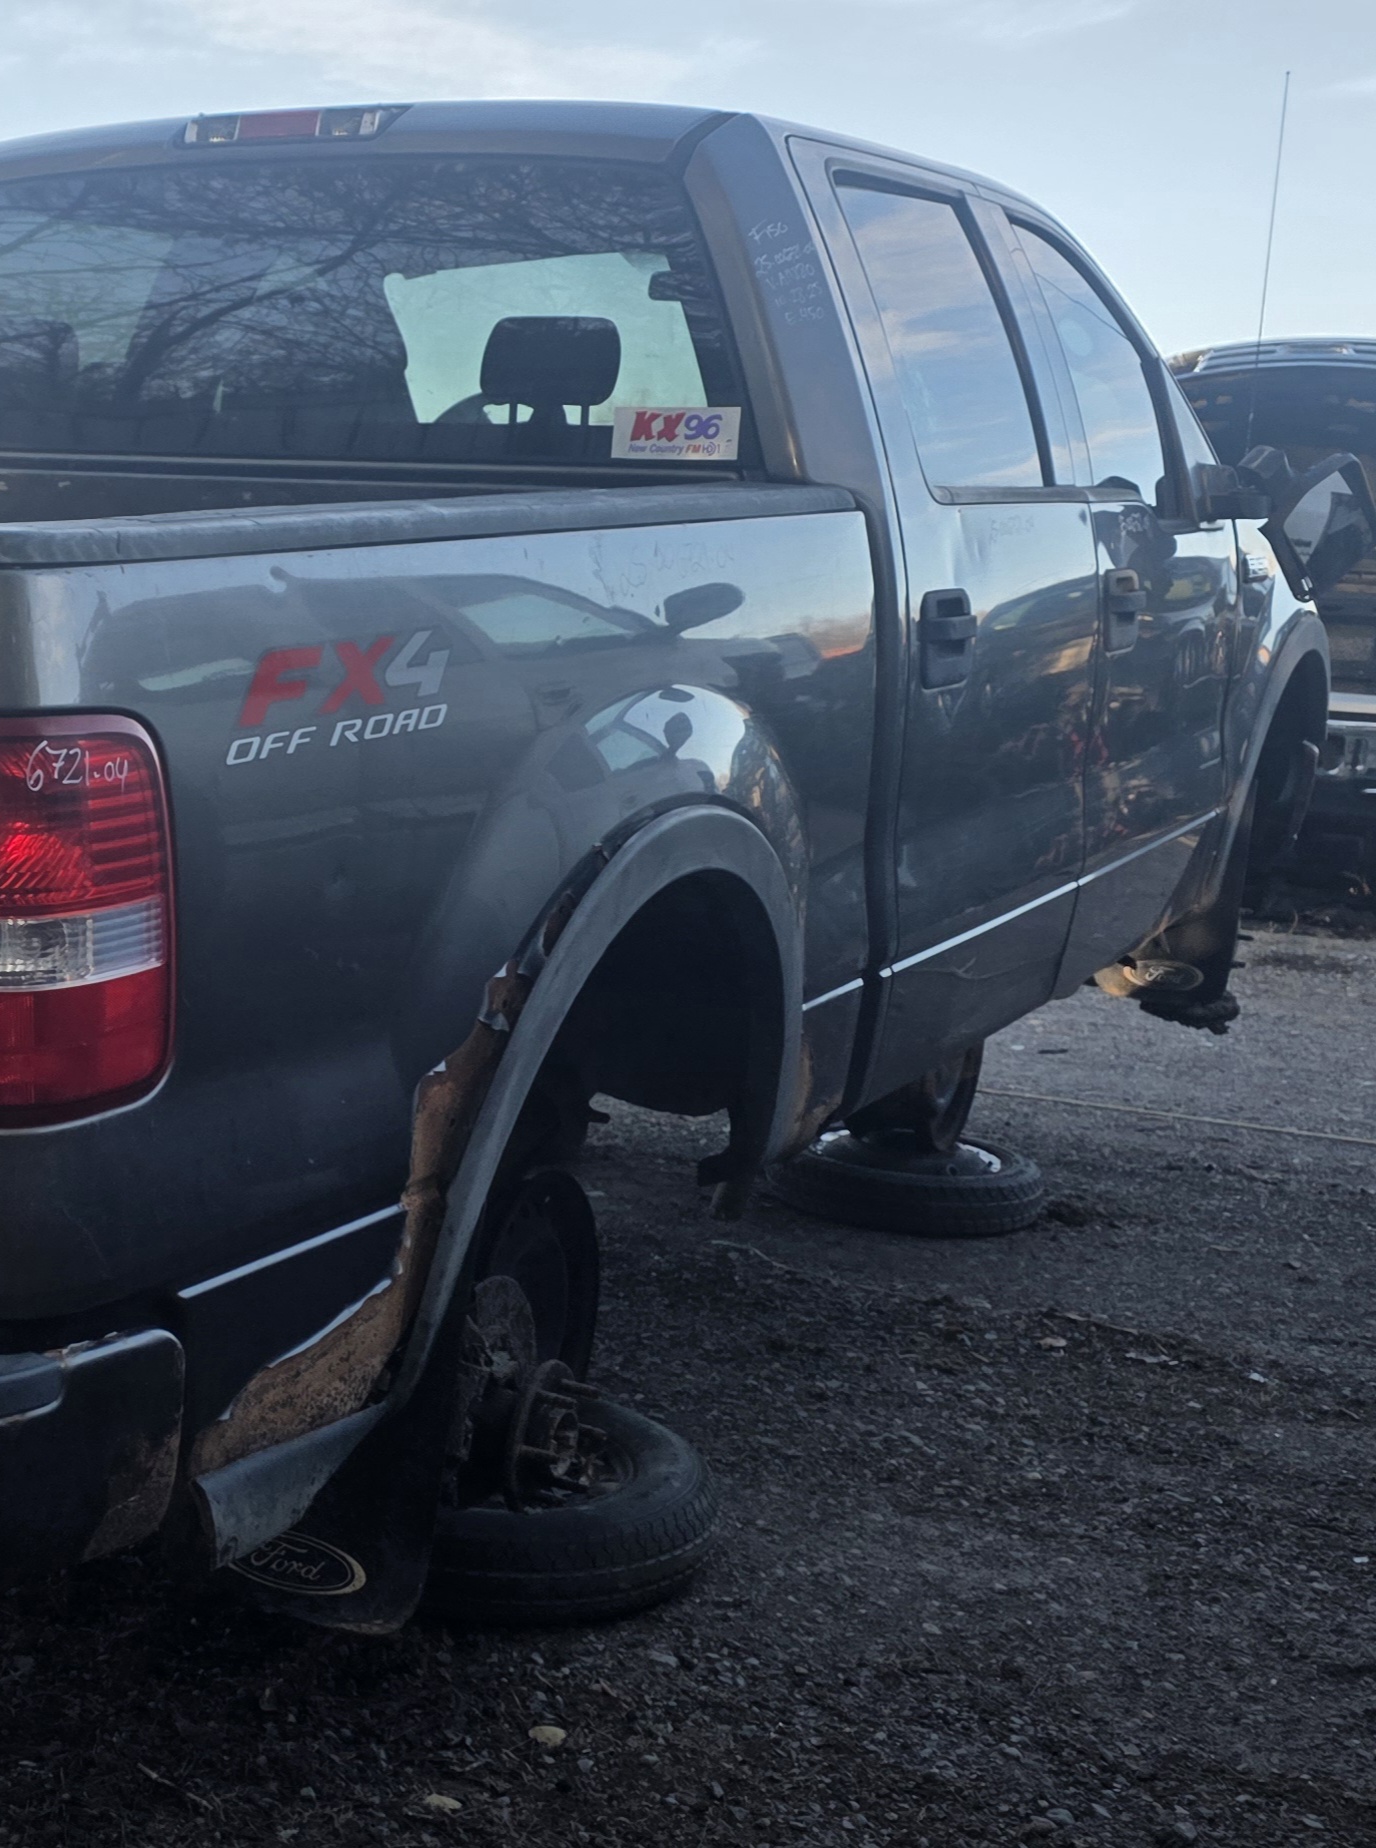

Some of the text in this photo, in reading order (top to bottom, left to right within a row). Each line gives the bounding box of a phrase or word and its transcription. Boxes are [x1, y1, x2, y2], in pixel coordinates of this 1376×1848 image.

[649, 443, 684, 455] Country
[685, 444, 701, 454] FM
[238, 629, 451, 728] FX4
[226, 703, 448, 766] OFF ROAD
[250, 1538, 326, 1581] Ford
